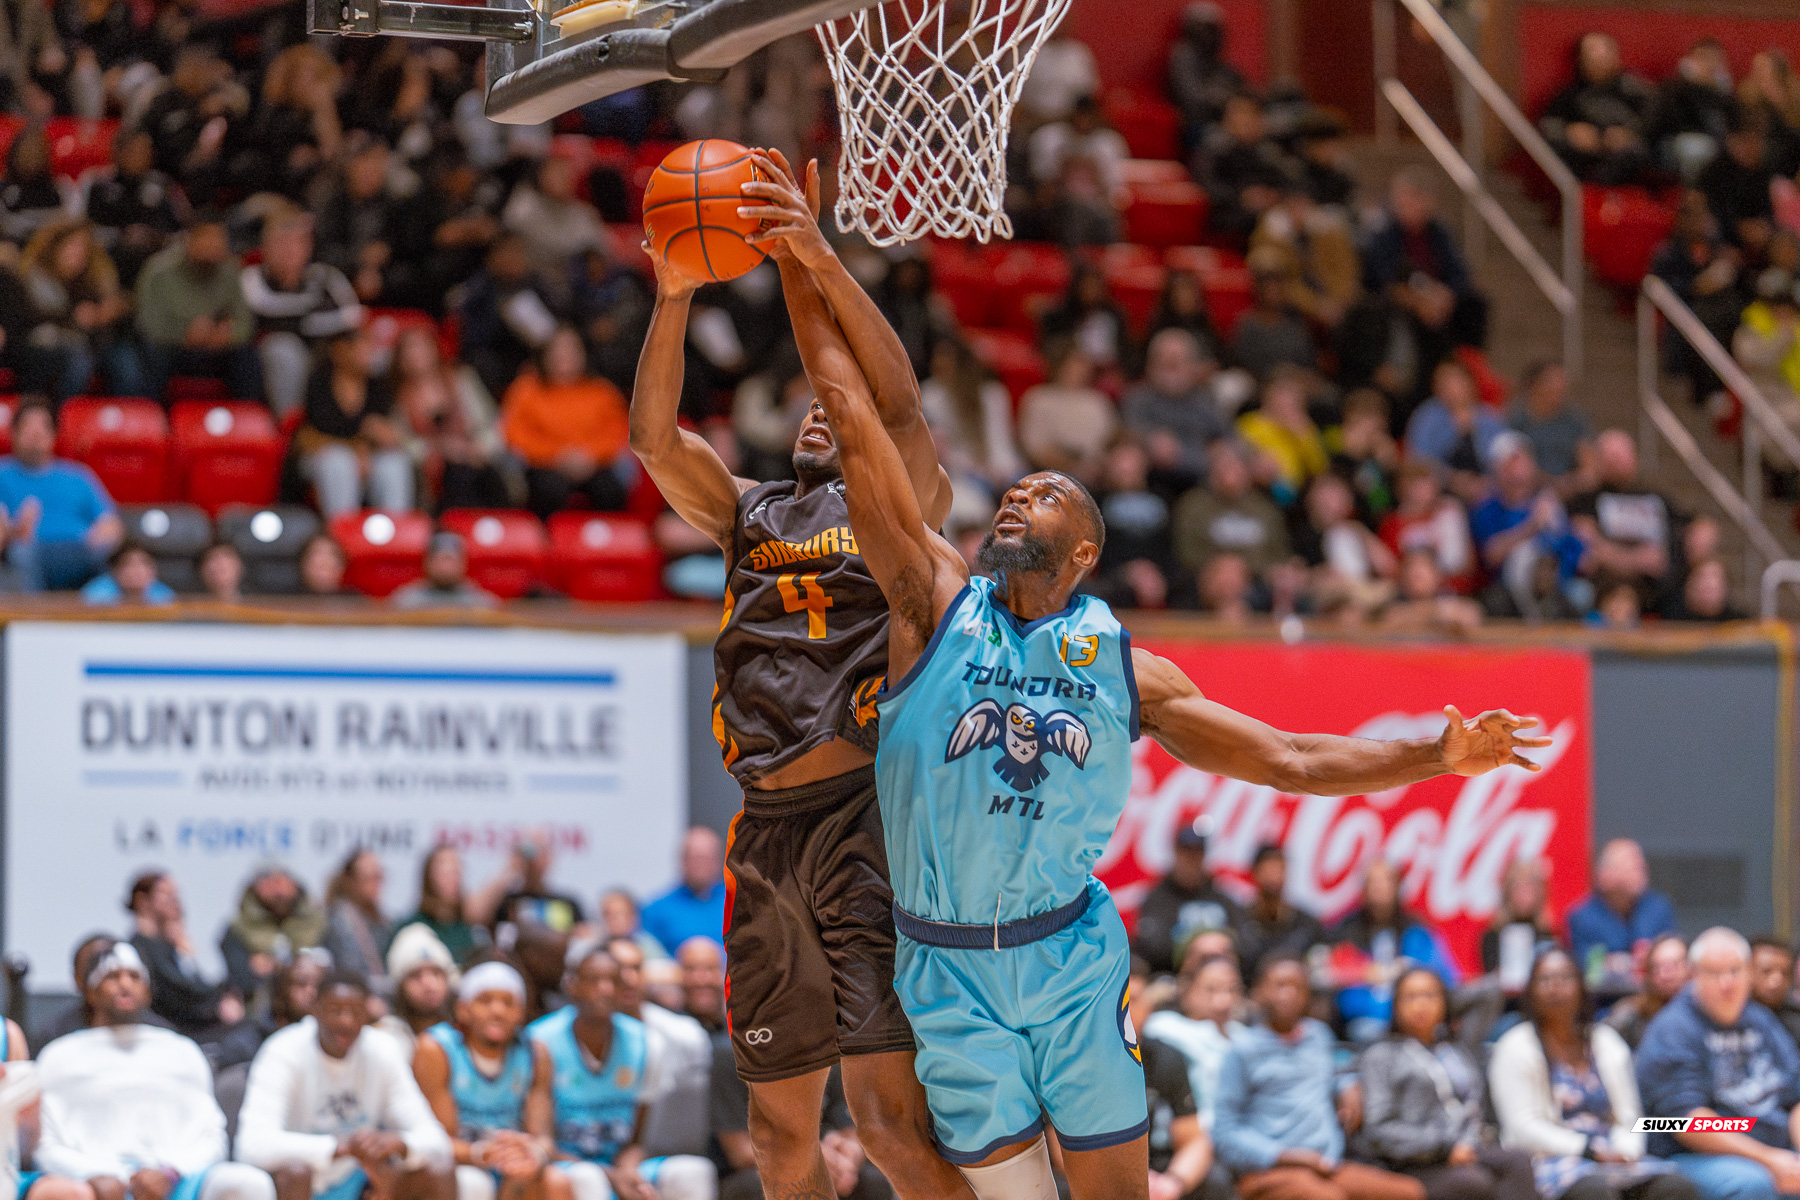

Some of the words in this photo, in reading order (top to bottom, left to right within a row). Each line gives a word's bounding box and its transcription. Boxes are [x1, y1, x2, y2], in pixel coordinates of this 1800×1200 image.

[776, 571, 834, 639] 4
[1059, 632, 1099, 667] 13
[961, 660, 1097, 701] TOUNDRA
[81, 698, 318, 755] DUNTON
[337, 700, 620, 761] RAINVILLE
[987, 795, 1045, 821] MTL
[113, 817, 163, 855] LA
[177, 816, 297, 856] FORCE
